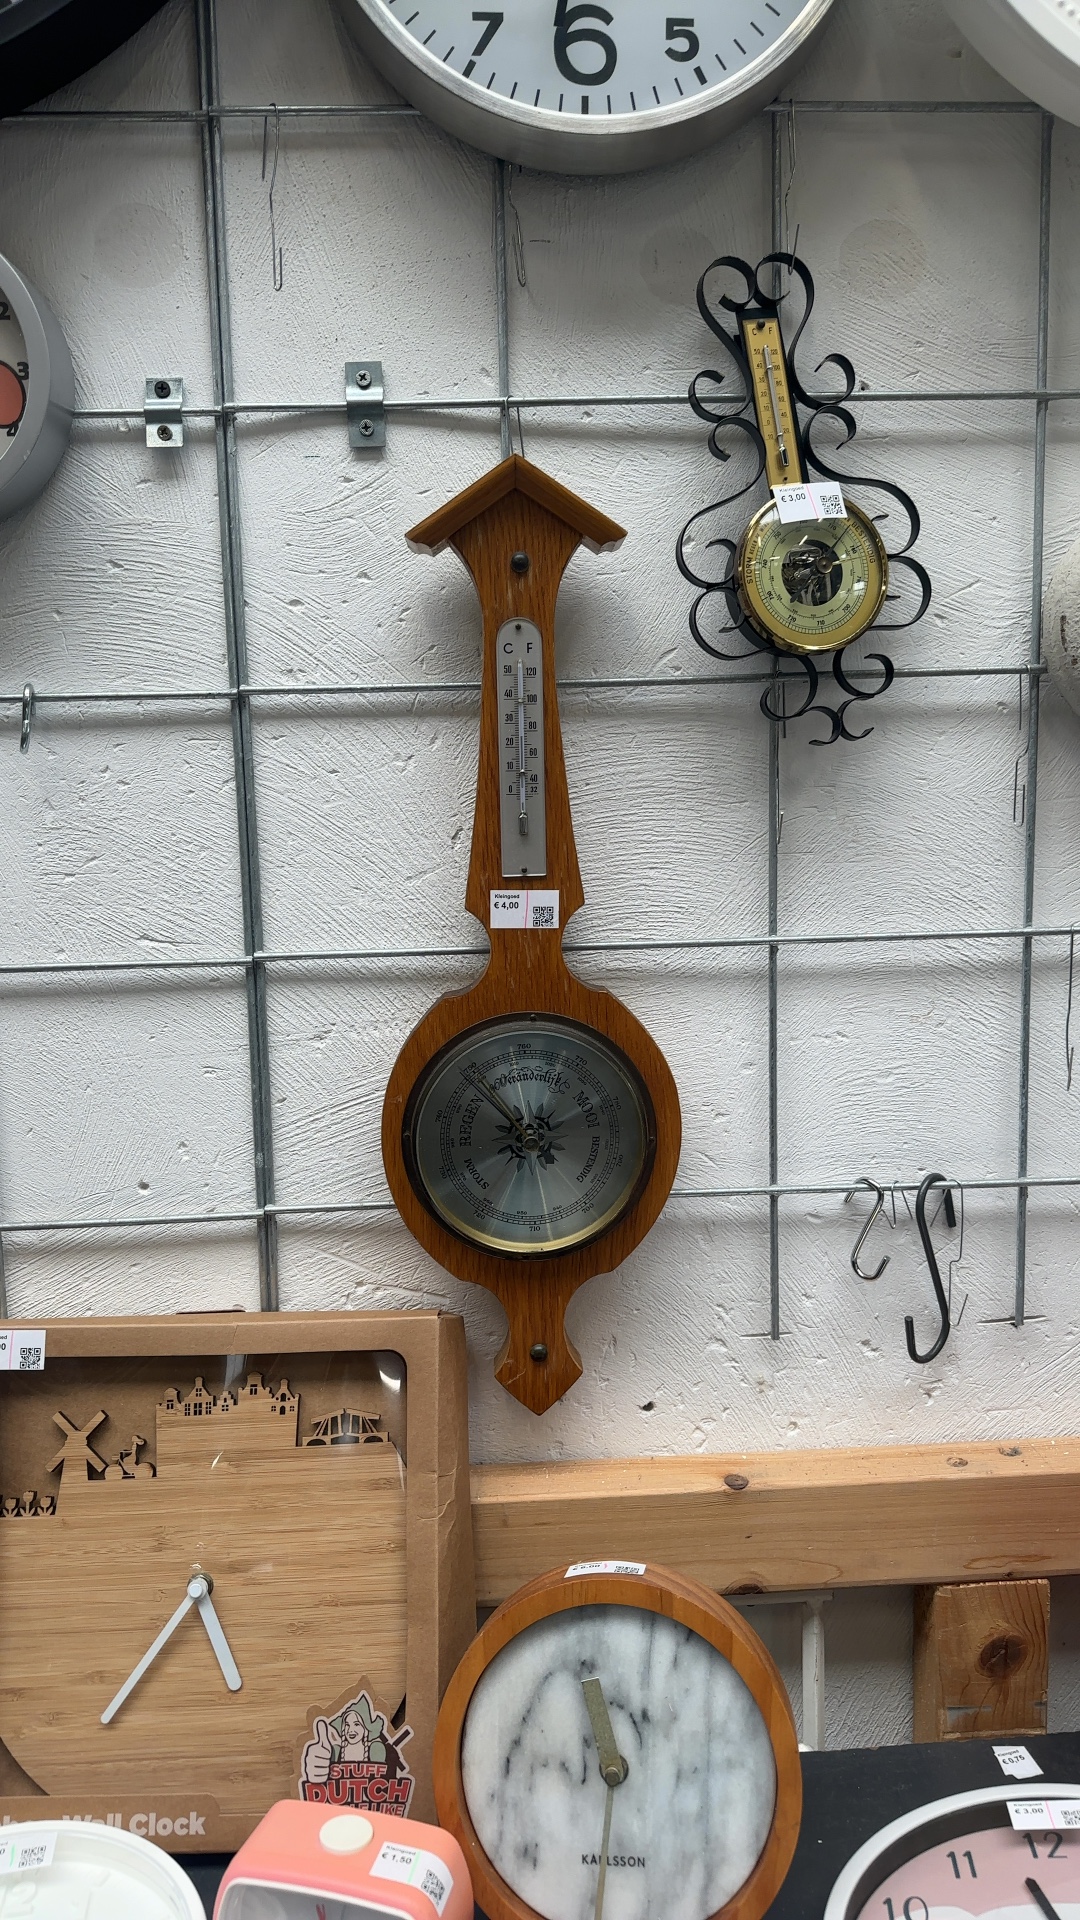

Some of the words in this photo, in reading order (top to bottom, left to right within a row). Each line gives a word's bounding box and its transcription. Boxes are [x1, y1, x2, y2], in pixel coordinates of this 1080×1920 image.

[471, 11, 504, 57] 7
[664, 17, 700, 63] 5
[553, 4, 618, 86] 6
[0, 302, 11, 321] 2
[751, 328, 757, 336] C
[768, 327, 773, 335] F
[16, 361, 30, 381] 3
[6, 421, 19, 437] 4
[788, 493, 806, 502] 3,00
[851, 522, 876, 564] BESTENDIG
[746, 554, 755, 585] STORM
[816, 619, 826, 627] 710
[503, 642, 514, 654] C
[526, 642, 534, 654] F
[503, 664, 513, 675] 50
[525, 667, 537, 677] 120
[504, 689, 513, 698] 40
[526, 694, 538, 703] 100
[504, 713, 514, 723] 30
[528, 721, 537, 730] 80
[505, 737, 514, 746] 20
[529, 748, 538, 757] 60
[506, 761, 514, 771] 10
[529, 774, 538, 783] 40
[508, 784, 513, 794] 0
[501, 902, 519, 911] 4,00
[575, 1054, 588, 1066] 770
[463, 1062, 477, 1074] 750
[572, 1090, 600, 1129] MOOI
[459, 1094, 484, 1147] REGEN
[576, 1136, 600, 1183] BESTENDIG
[463, 1157, 490, 1190] STORM
[473, 1210, 486, 1220] 720
[1008, 1754, 1026, 1764] 0,75
[330, 1763, 387, 1779] STUFF
[305, 1778, 411, 1806] DUTCH
[128, 1811, 206, 1836] Clock
[1022, 1831, 1068, 1860] 12
[946, 1850, 978, 1879] 11
[883, 1895, 930, 1920] 10
